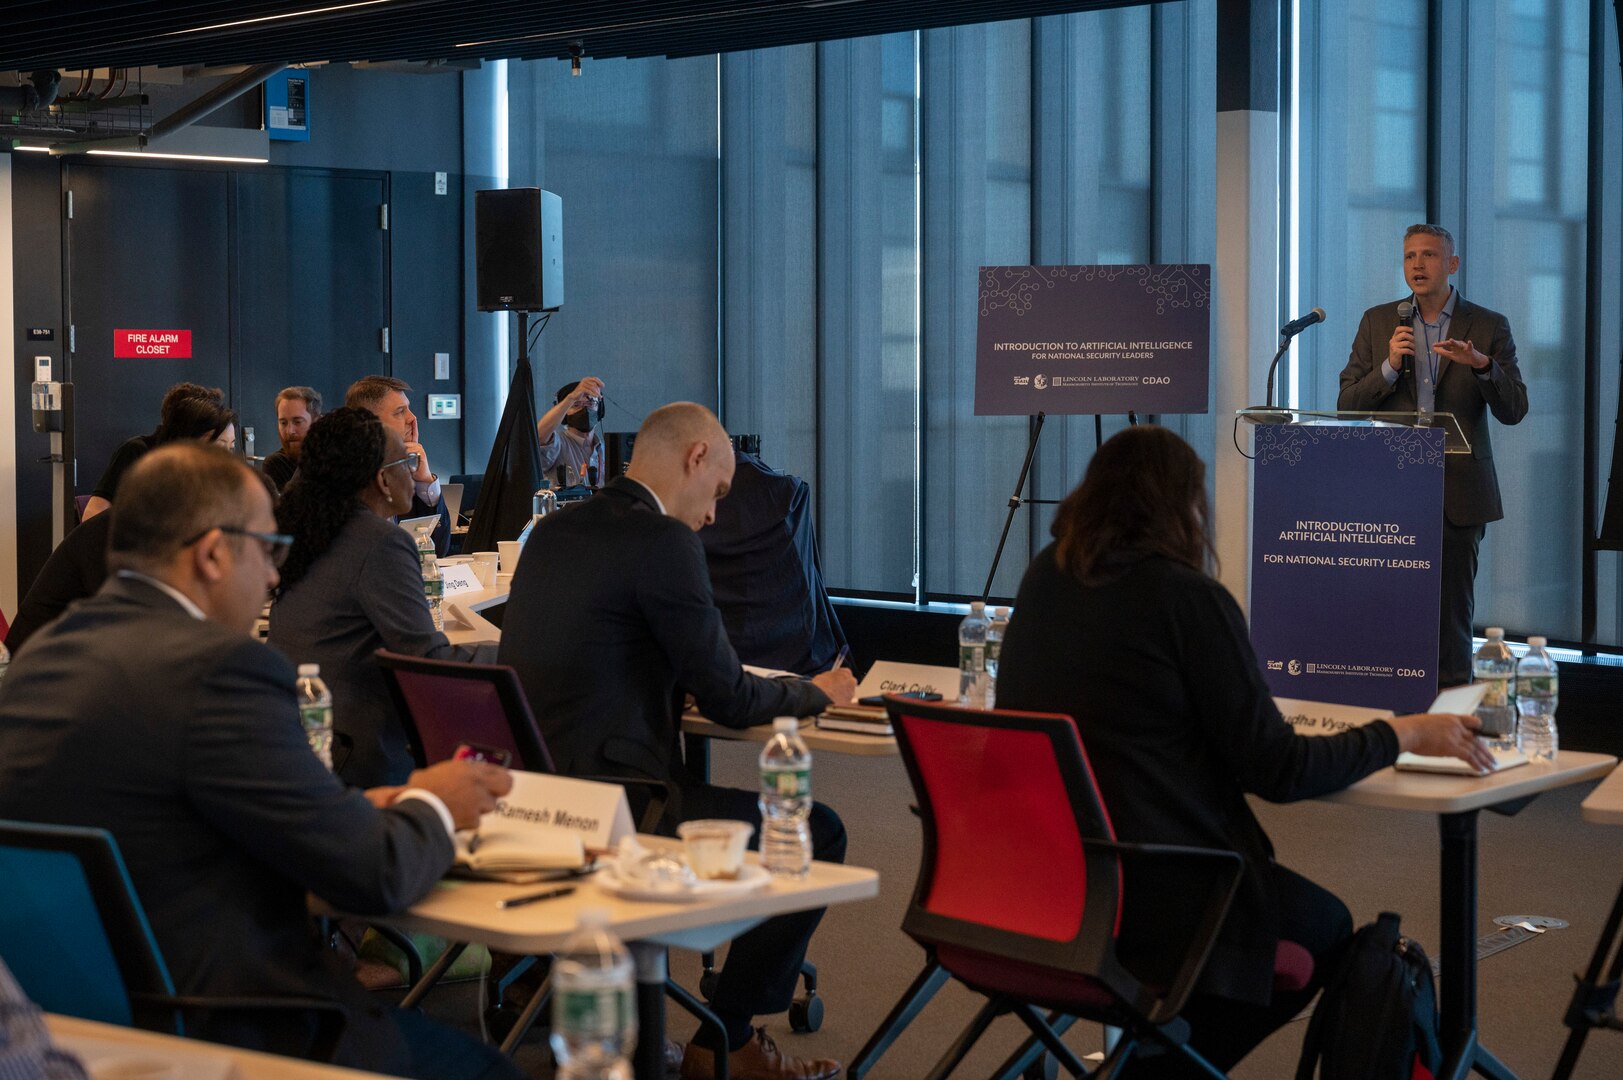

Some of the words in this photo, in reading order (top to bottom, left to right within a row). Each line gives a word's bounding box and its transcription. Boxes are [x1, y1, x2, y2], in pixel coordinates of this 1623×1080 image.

[128, 334, 148, 342] FIRE
[149, 334, 178, 343] ALARM
[136, 345, 170, 354] CLOSET
[994, 342, 1064, 351] INTRODUCTION
[1066, 342, 1078, 350] TO
[1080, 342, 1128, 350] ARTIFICIAL
[1130, 341, 1192, 350] INTELLIGENCE
[1142, 376, 1170, 384] CDAO
[1296, 520, 1381, 533] INTRODUCTION
[1384, 524, 1400, 534] TO
[1278, 531, 1337, 542] ARTIFICIAL
[1340, 533, 1416, 545] INTELLIGENCE
[1264, 554, 1284, 564] FOR
[1286, 556, 1336, 566] NATIONAL
[1338, 557, 1386, 568] SECURITY
[1387, 559, 1431, 570] LEADERS
[1396, 668, 1426, 678] CDAO
[880, 680, 906, 692] Clark
[1282, 714, 1316, 726] udha
[495, 801, 551, 823] Ramesh
[554, 809, 600, 832] Menon
